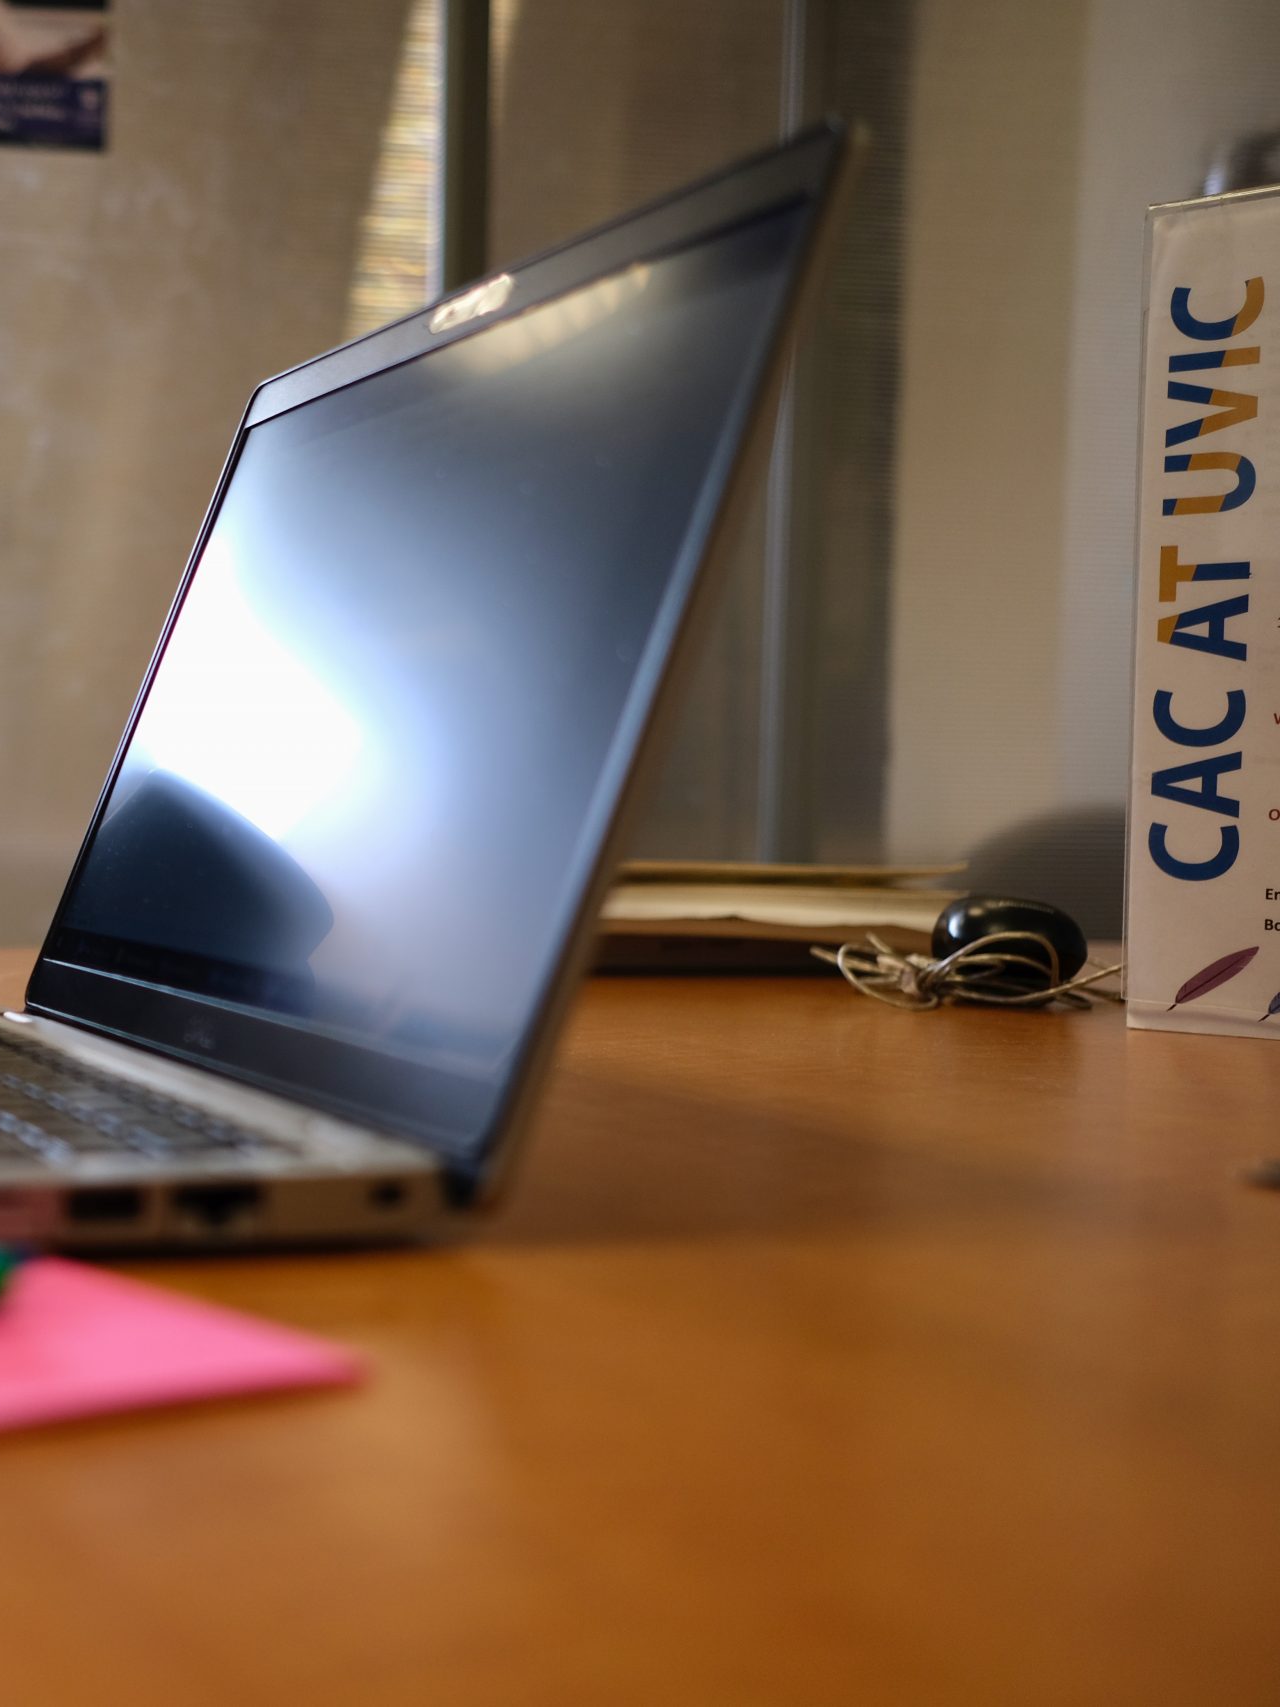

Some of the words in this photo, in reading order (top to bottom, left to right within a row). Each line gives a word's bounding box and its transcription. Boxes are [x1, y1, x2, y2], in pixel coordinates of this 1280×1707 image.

[1162, 276, 1264, 516] UVIC
[1157, 545, 1251, 661] AT
[1148, 689, 1246, 881] CAC
